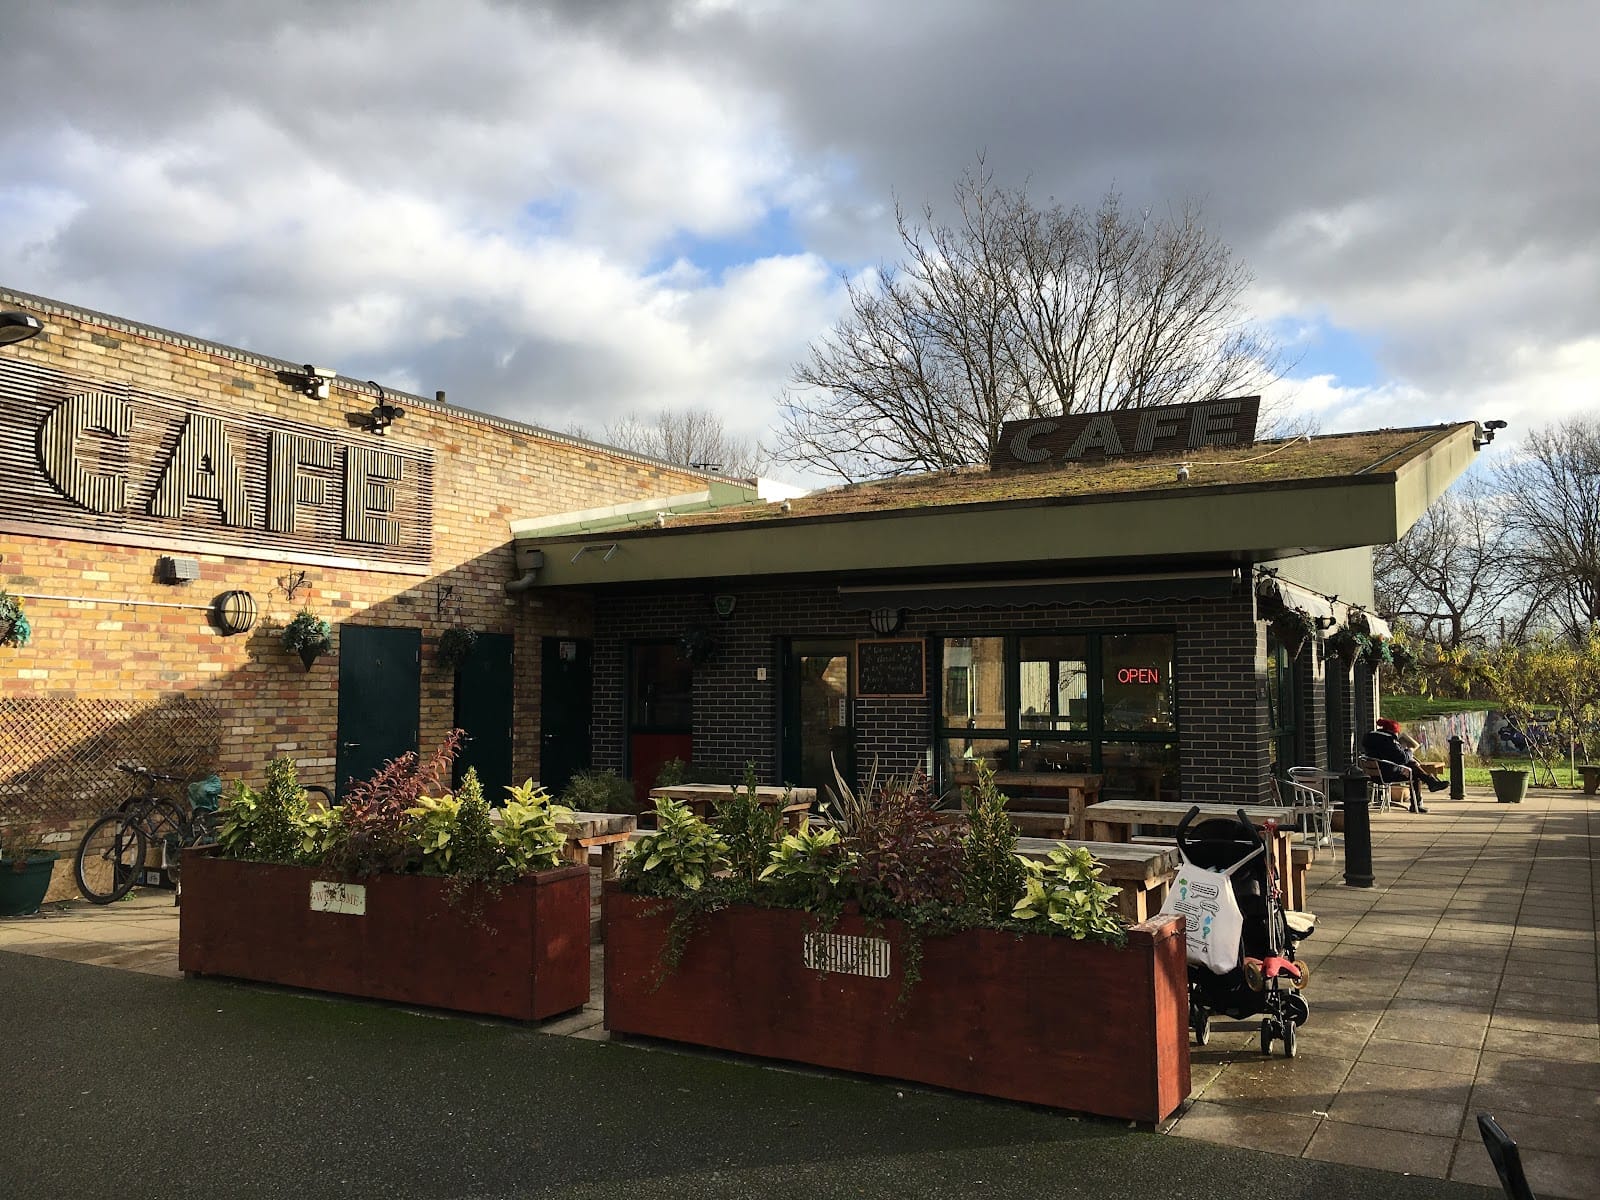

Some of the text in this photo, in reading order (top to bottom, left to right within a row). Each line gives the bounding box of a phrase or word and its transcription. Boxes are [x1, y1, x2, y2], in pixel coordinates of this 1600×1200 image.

[1010, 403, 1241, 463] CAFE
[37, 391, 404, 545] CAFE
[1117, 668, 1159, 683] OPEN
[314, 891, 360, 907] WECOME
